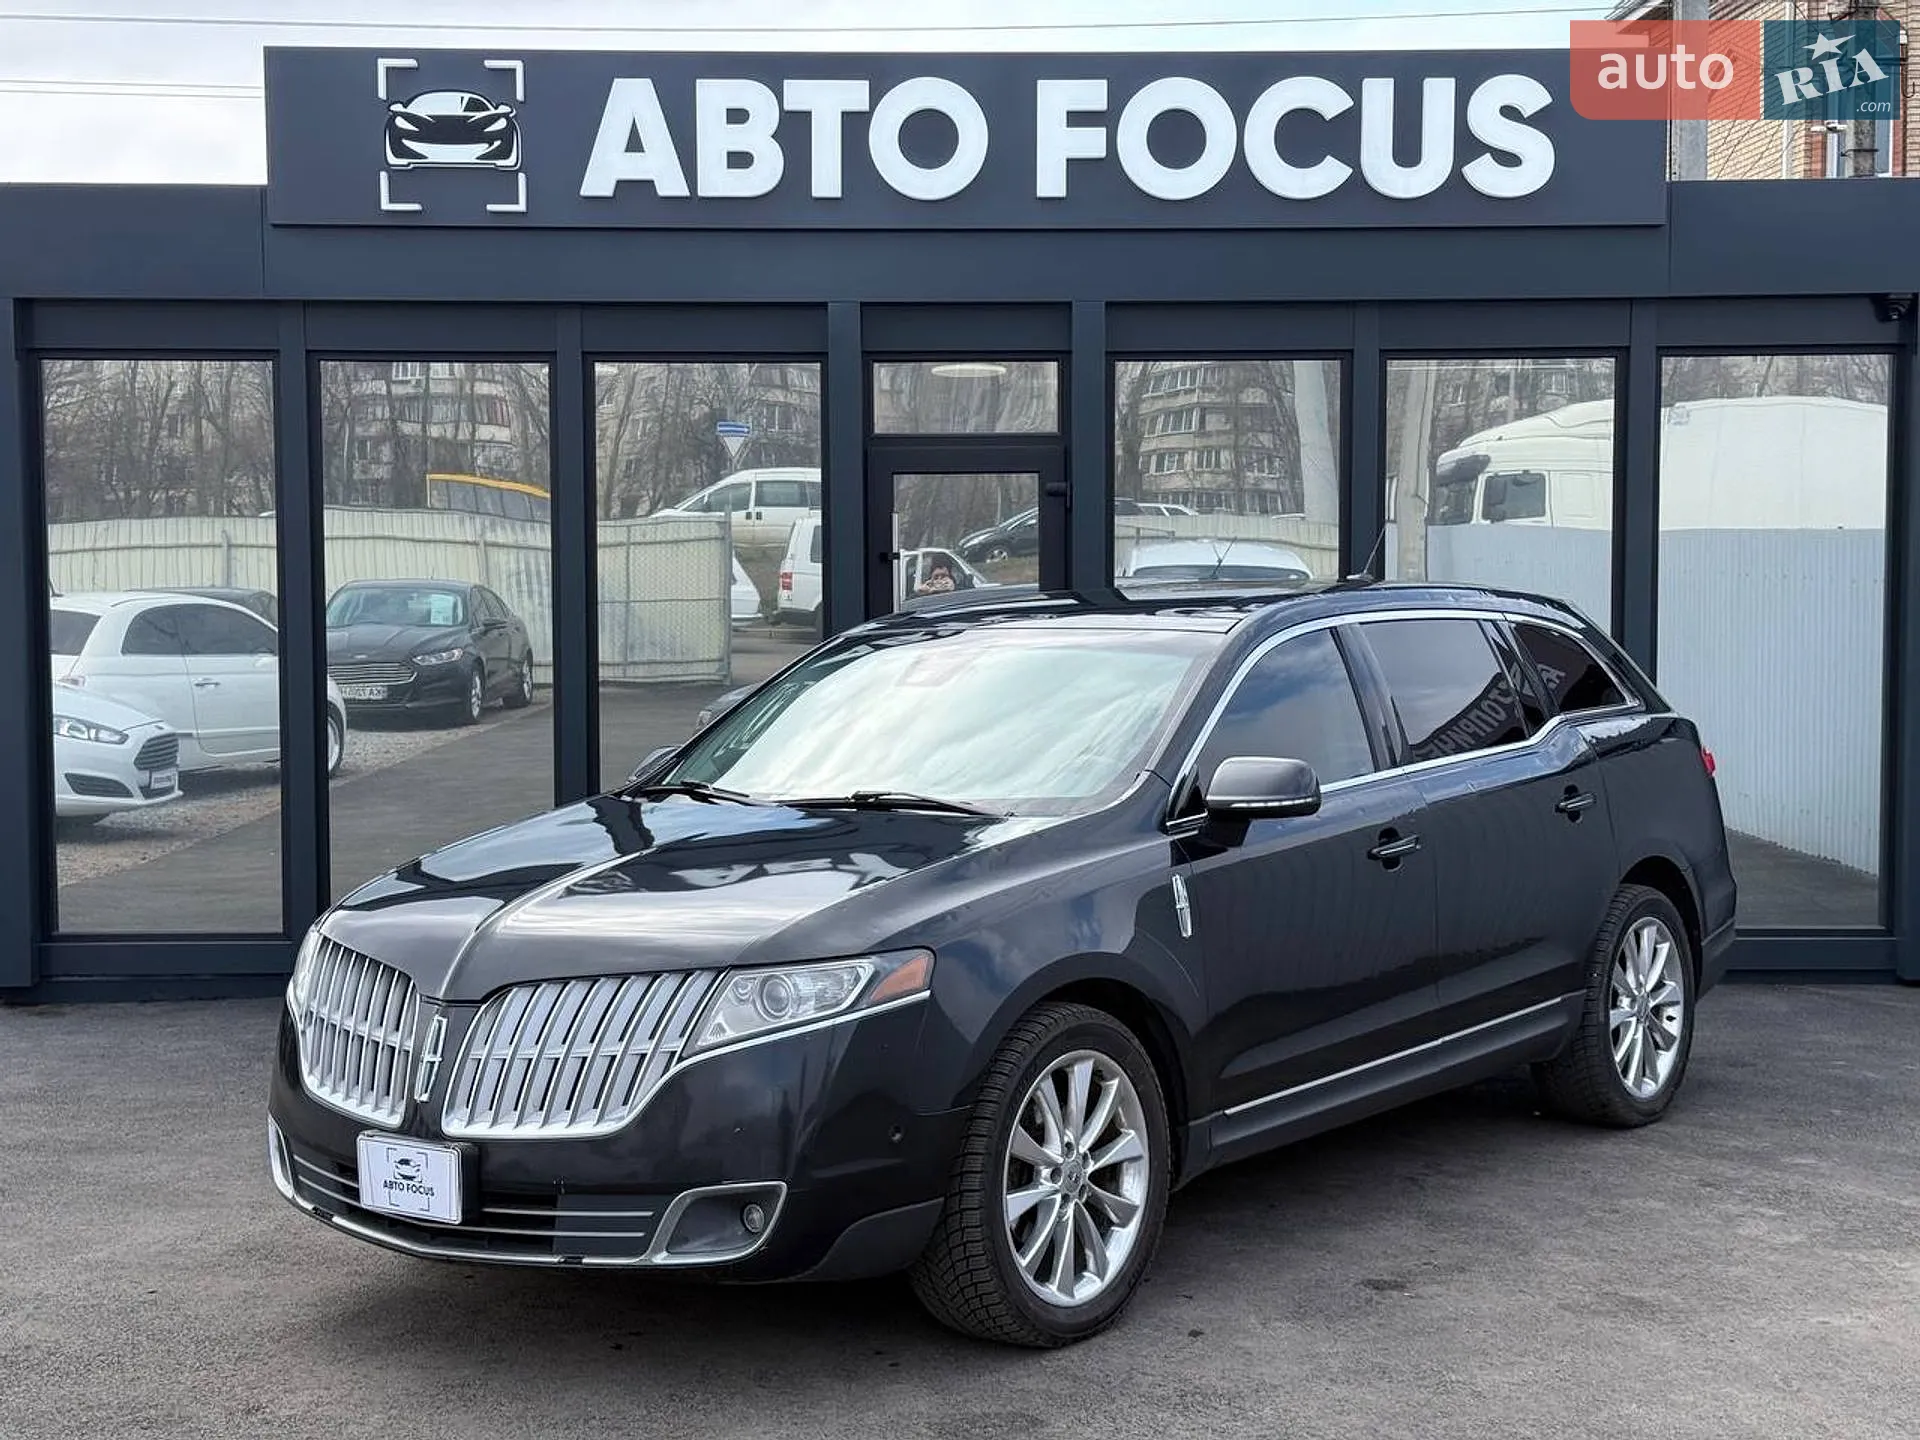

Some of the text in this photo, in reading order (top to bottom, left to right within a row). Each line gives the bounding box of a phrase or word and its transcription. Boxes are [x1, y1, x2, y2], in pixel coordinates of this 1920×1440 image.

[579, 75, 1556, 201] АВТО FOCUS
[383, 1180, 435, 1196] АВТО FOCUS
